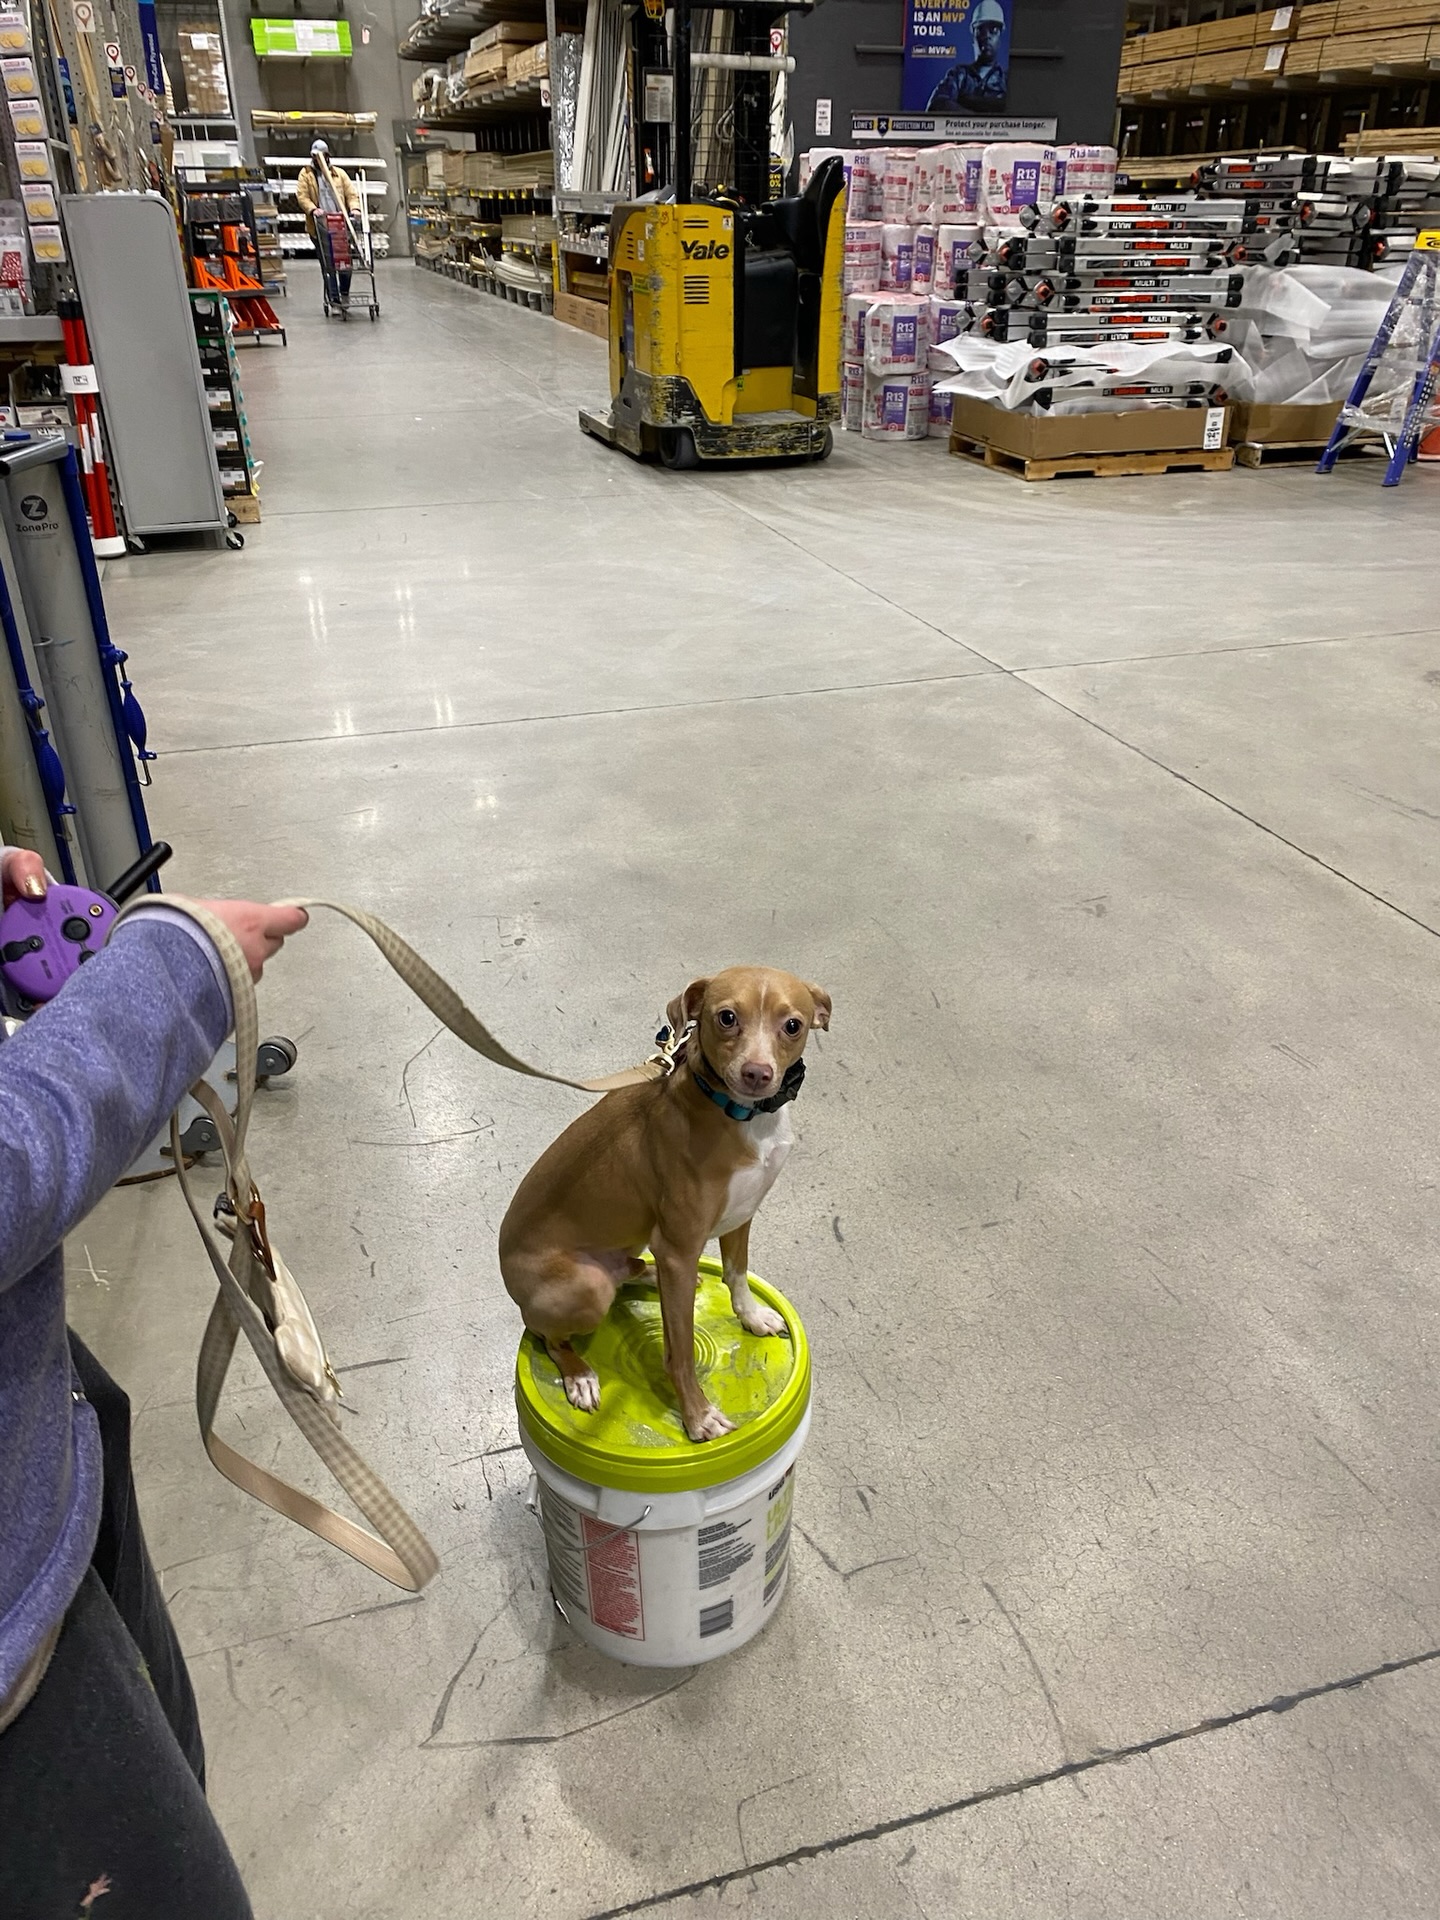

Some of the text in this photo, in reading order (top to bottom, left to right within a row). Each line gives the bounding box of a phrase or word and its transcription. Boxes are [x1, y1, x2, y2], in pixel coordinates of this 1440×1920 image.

[914, 0, 970, 9] EVERY PRO
[914, 12, 966, 23] IS AN MVP
[913, 25, 946, 36] TO US.
[945, 119, 1046, 129] Protect your purchase longer.
[1069, 149, 1086, 158] R13
[1016, 168, 1037, 180] R13
[680, 239, 730, 260] Yale
[954, 248, 969, 258] R1
[896, 322, 915, 333] R13
[911, 375, 925, 385] R13
[886, 391, 904, 402] R13
[15, 522, 59, 532] ZonePro
